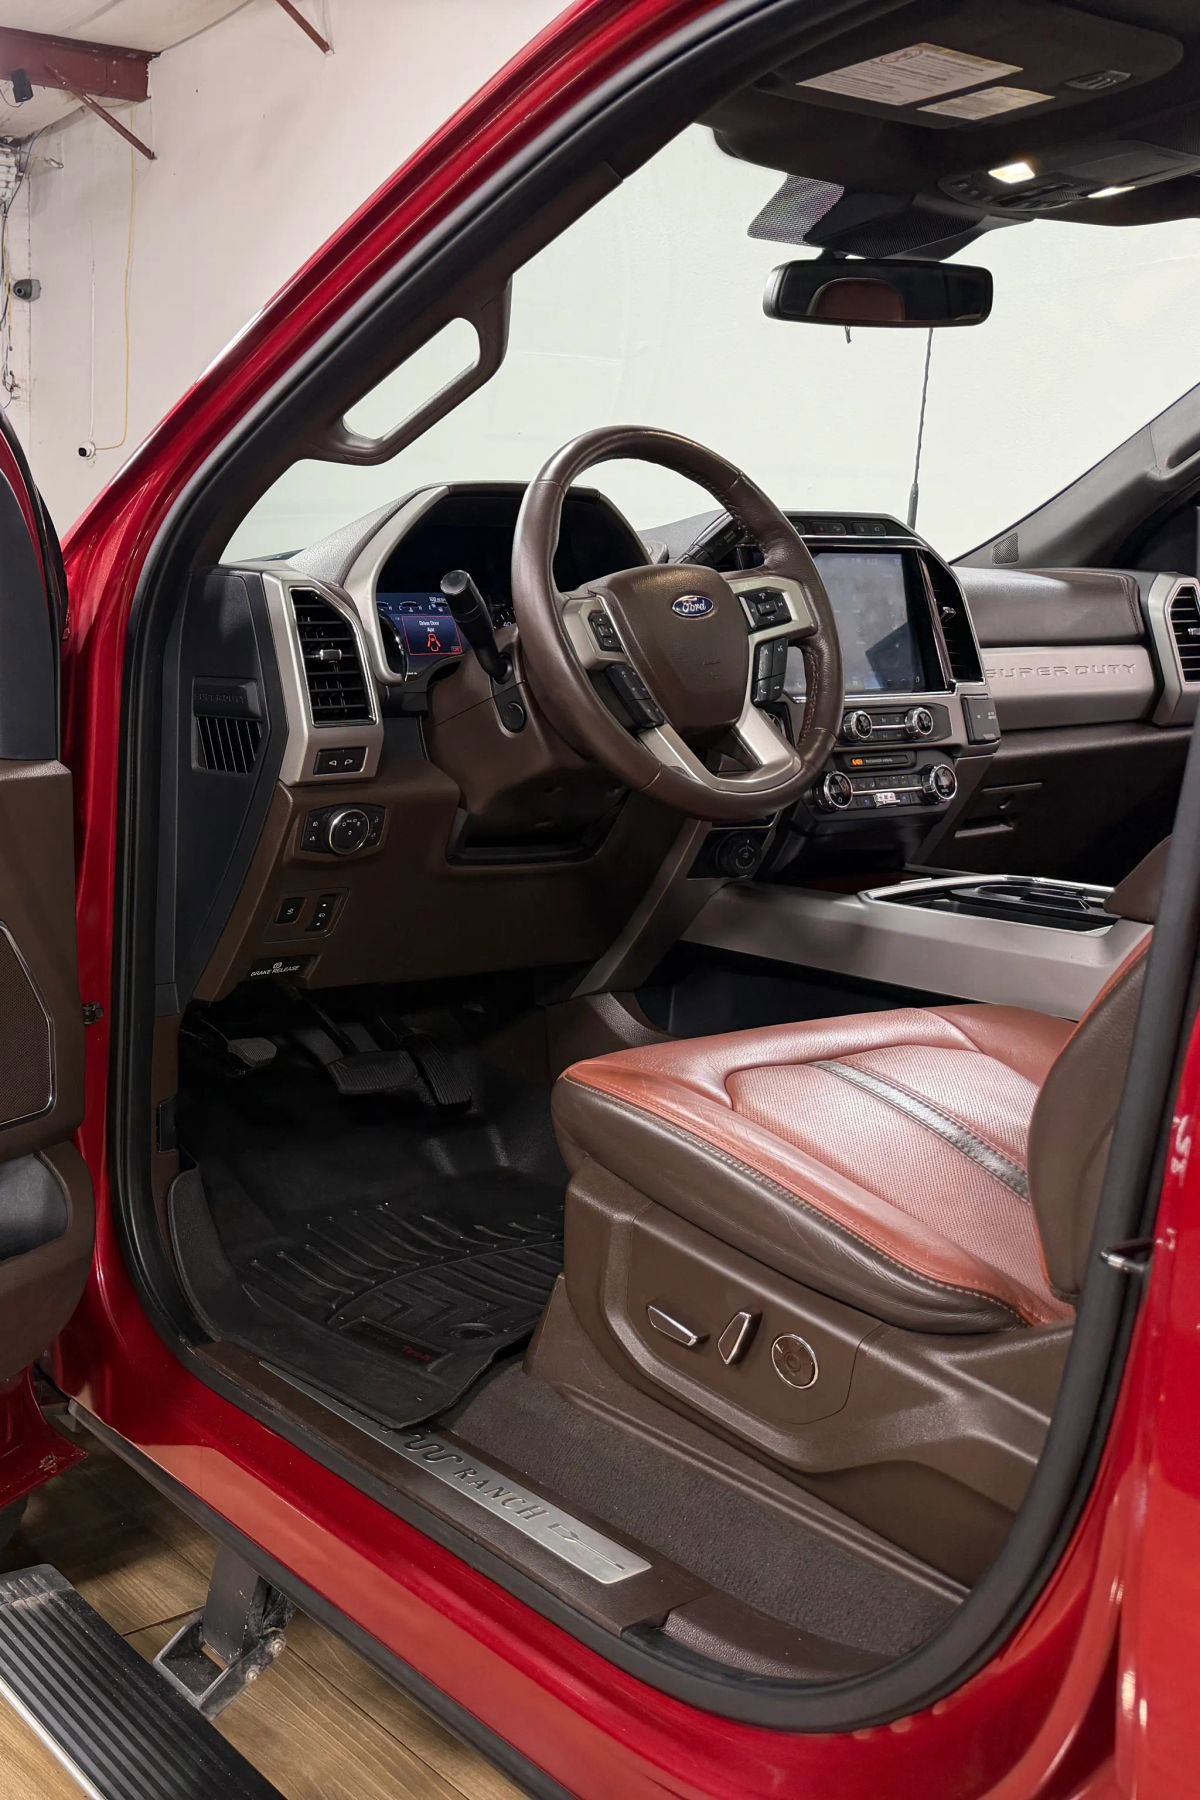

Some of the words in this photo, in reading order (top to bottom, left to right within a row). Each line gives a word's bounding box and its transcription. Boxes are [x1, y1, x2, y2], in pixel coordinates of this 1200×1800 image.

[676, 597, 708, 614] Ford
[985, 665, 1069, 679] SUPER
[1074, 663, 1136, 676] DUTY
[250, 969, 272, 977] BRAKE
[272, 965, 301, 974] RELEASE
[452, 1467, 549, 1522] RANCH
